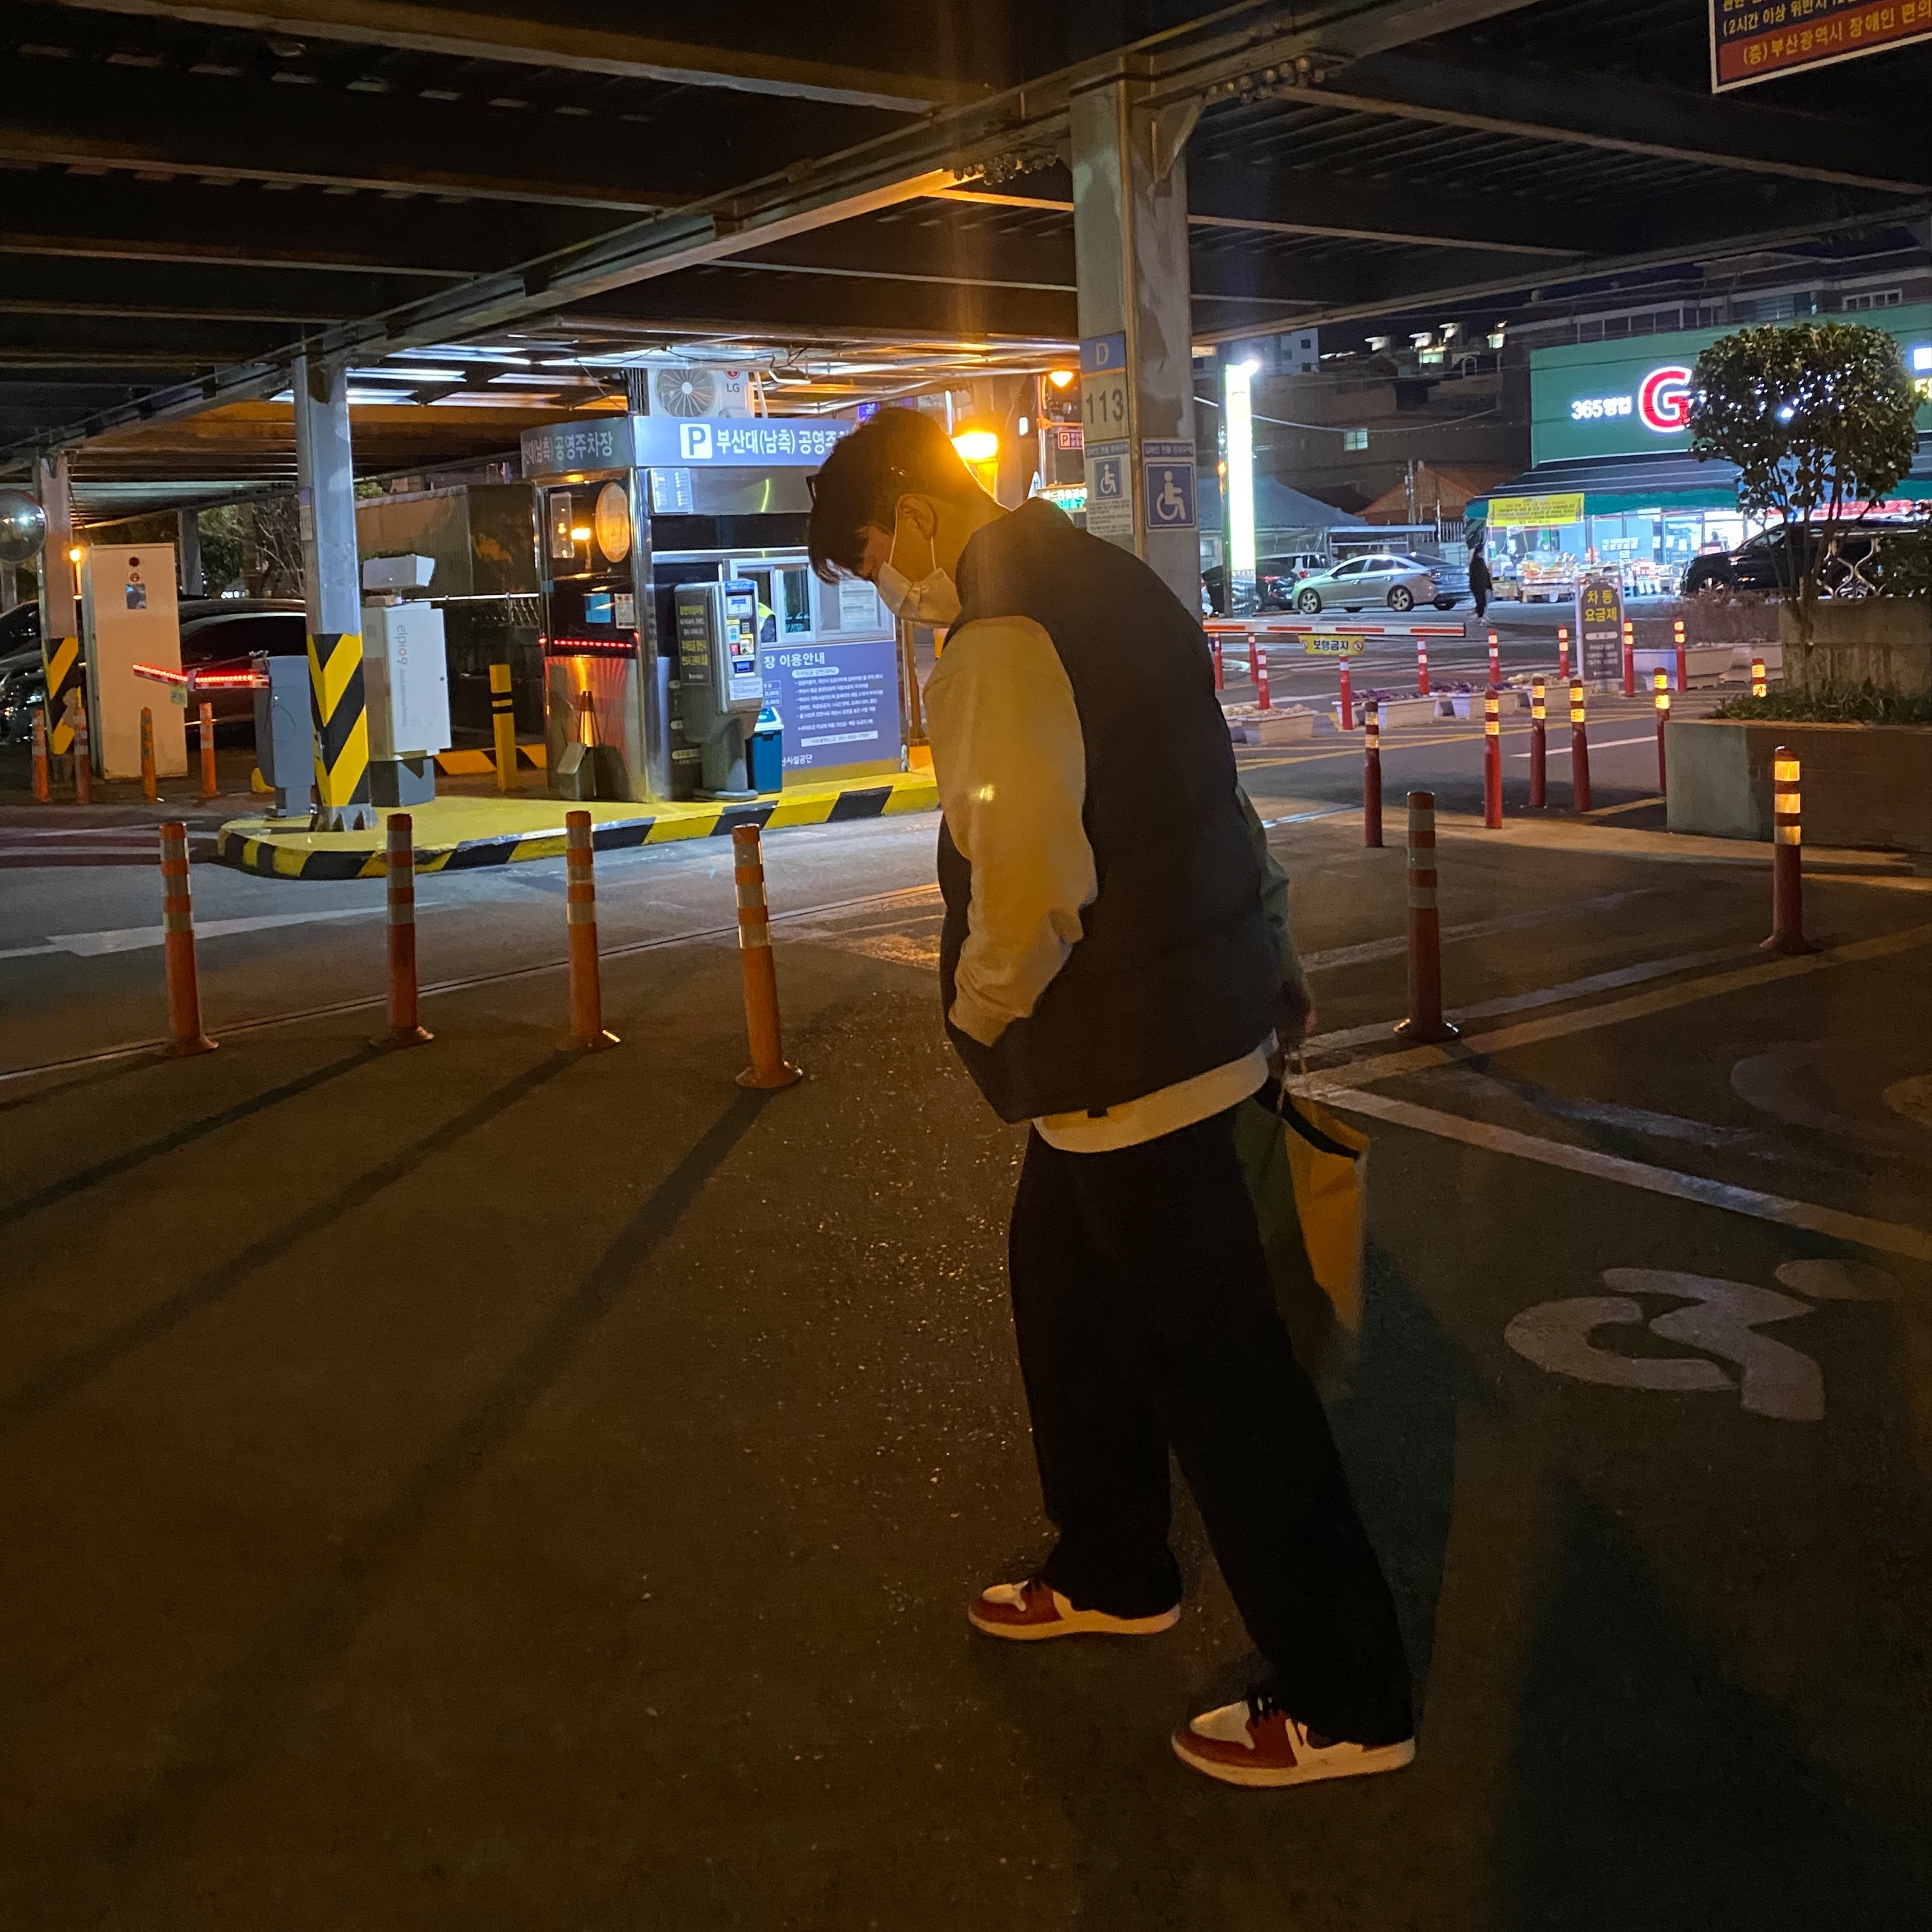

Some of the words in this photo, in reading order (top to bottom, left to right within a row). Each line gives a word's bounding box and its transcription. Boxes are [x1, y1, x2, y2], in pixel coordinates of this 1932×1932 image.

[1723, 11, 1759, 36] (2시간
[1763, 3, 1786, 24] 이상
[1849, 7, 1894, 38] 장애인
[1096, 342, 1109, 365] D
[726, 382, 740, 393] LG
[1085, 389, 1124, 424] 113
[555, 431, 613, 461] 공영주차장
[716, 429, 795, 455] 부산대(남측)
[799, 430, 847, 455] 공영주
[1584, 606, 1618, 622] 요금제
[1314, 640, 1349, 651] 보행금지
[779, 651, 825, 668] 이용안내
